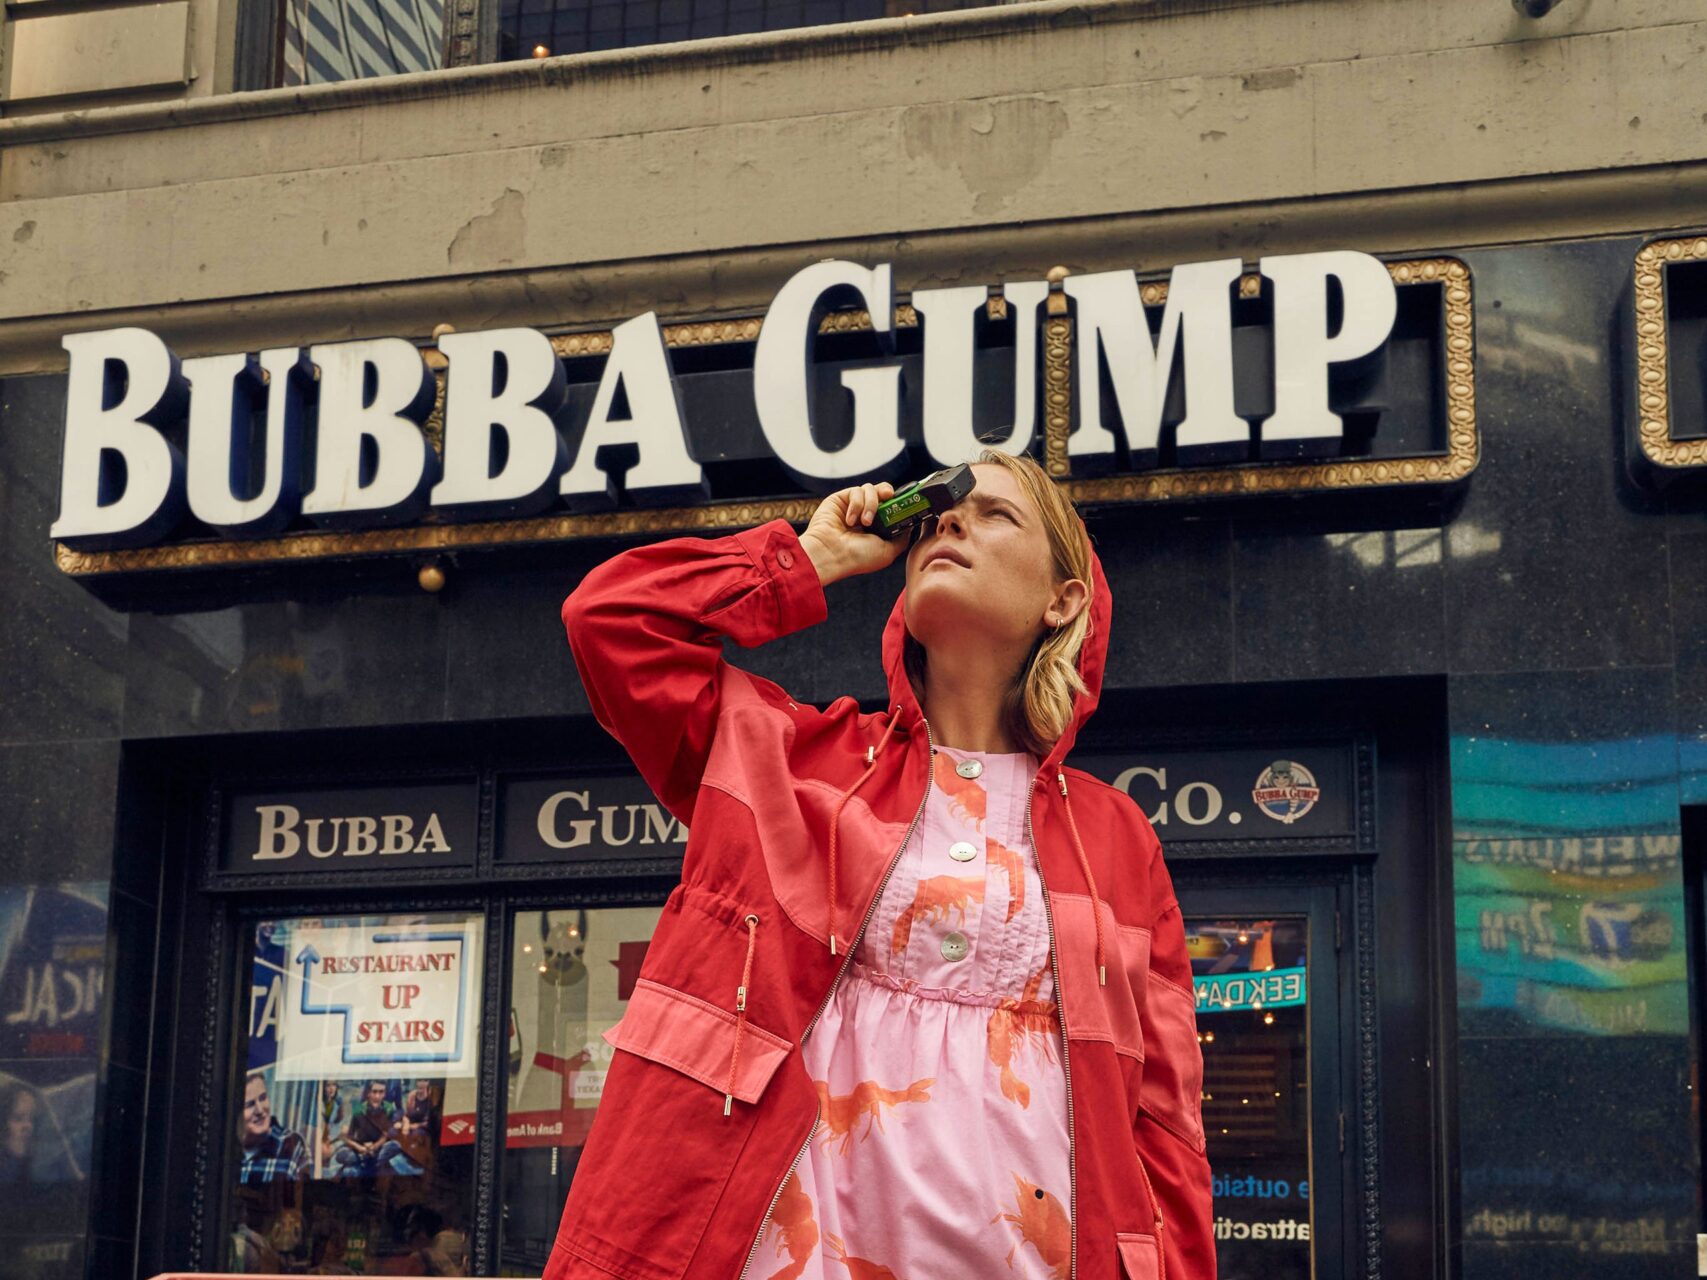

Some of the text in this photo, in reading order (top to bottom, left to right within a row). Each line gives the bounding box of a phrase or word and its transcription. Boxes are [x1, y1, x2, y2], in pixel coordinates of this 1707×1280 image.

[51, 250, 1397, 539] BUBBA GUMP
[252, 805, 451, 860] BUBBA
[321, 953, 456, 975] RESTAURANT
[382, 984, 420, 1010] UP
[356, 1020, 445, 1043] STAIRS
